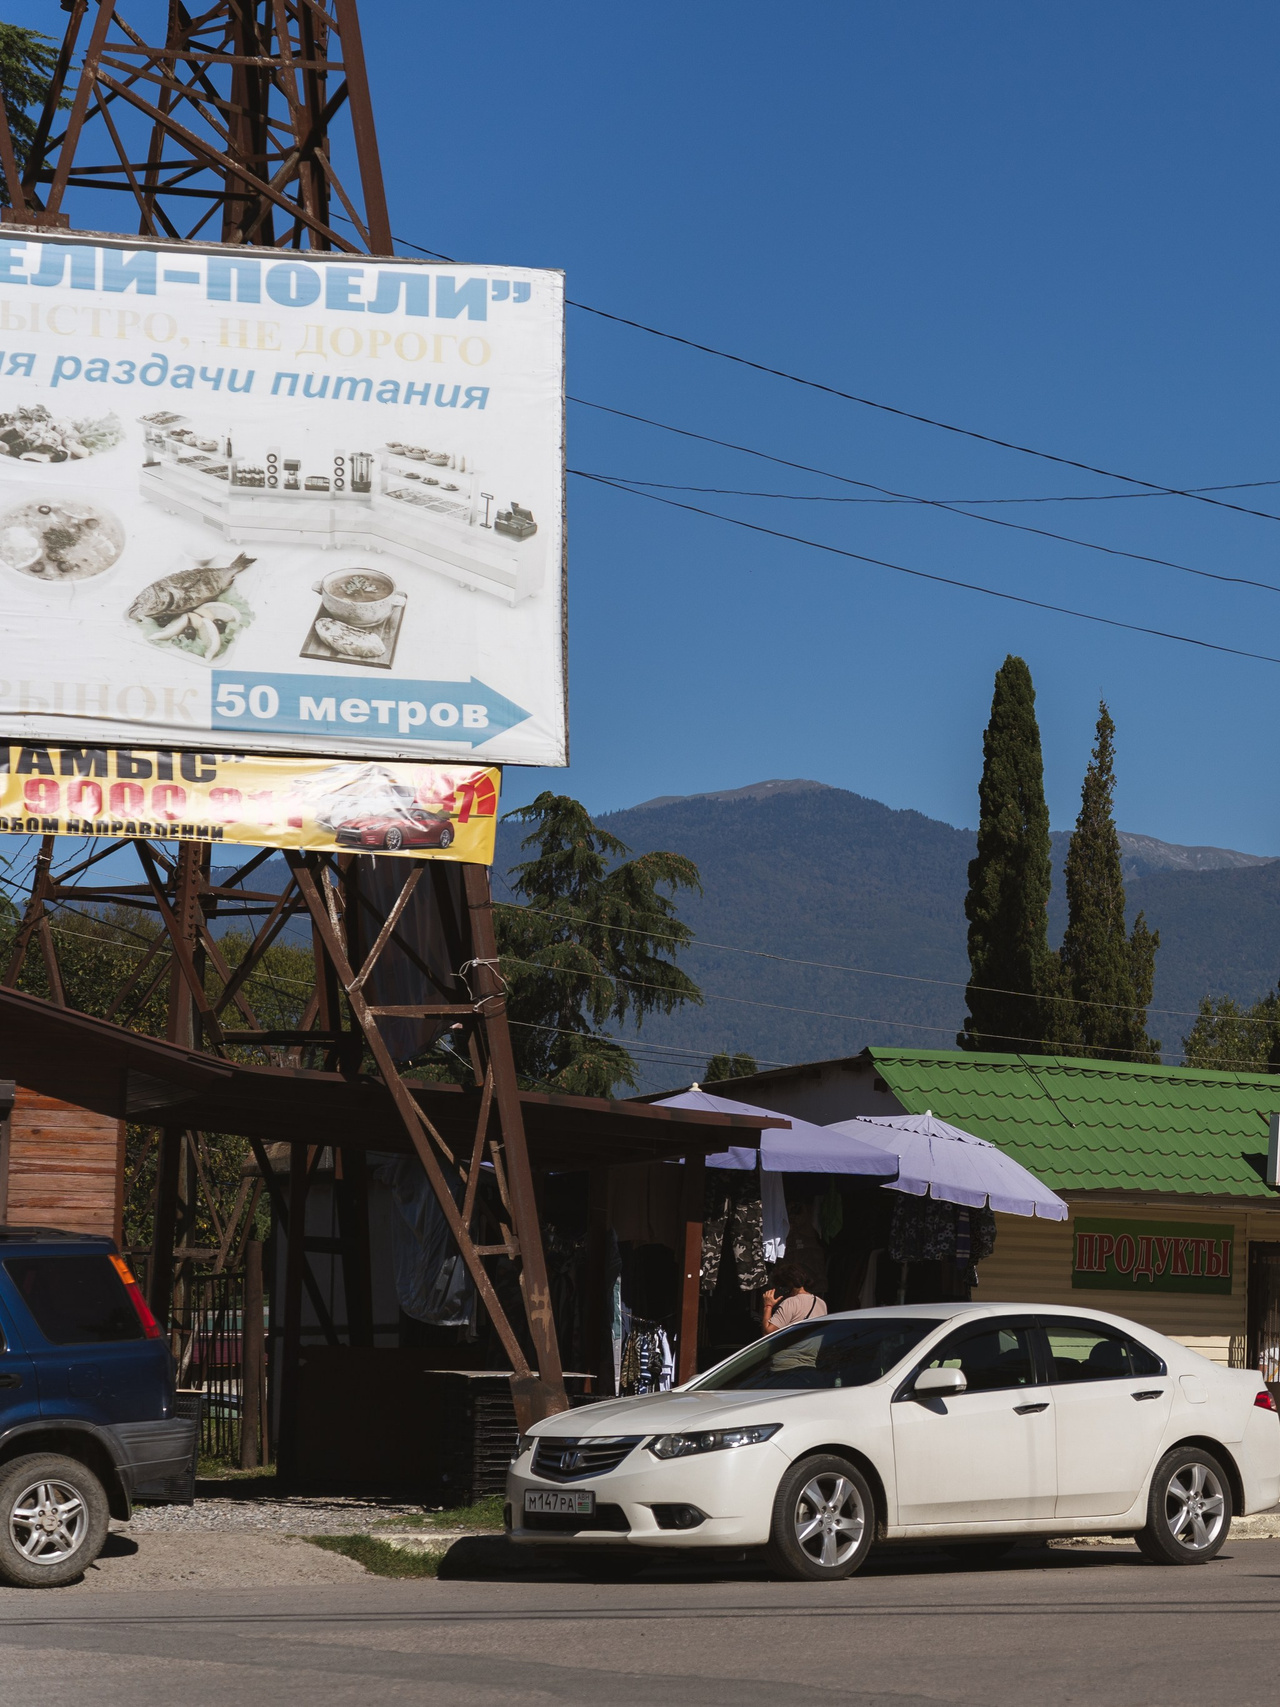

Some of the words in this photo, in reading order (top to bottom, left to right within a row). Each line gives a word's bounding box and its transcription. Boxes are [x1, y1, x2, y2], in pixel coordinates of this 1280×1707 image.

[216, 317, 282, 351] НЕ
[294, 323, 491, 367] ДОРОГО
[0, 350, 36, 377] я
[51, 352, 255, 393] раздачи
[270, 371, 490, 410] питания
[215, 683, 279, 719] 50
[300, 695, 489, 733] метров
[66, 818, 223, 842] НАПРАВЛЕНИИ
[1075, 1232, 1232, 1282] ПРОДУКТЫ
